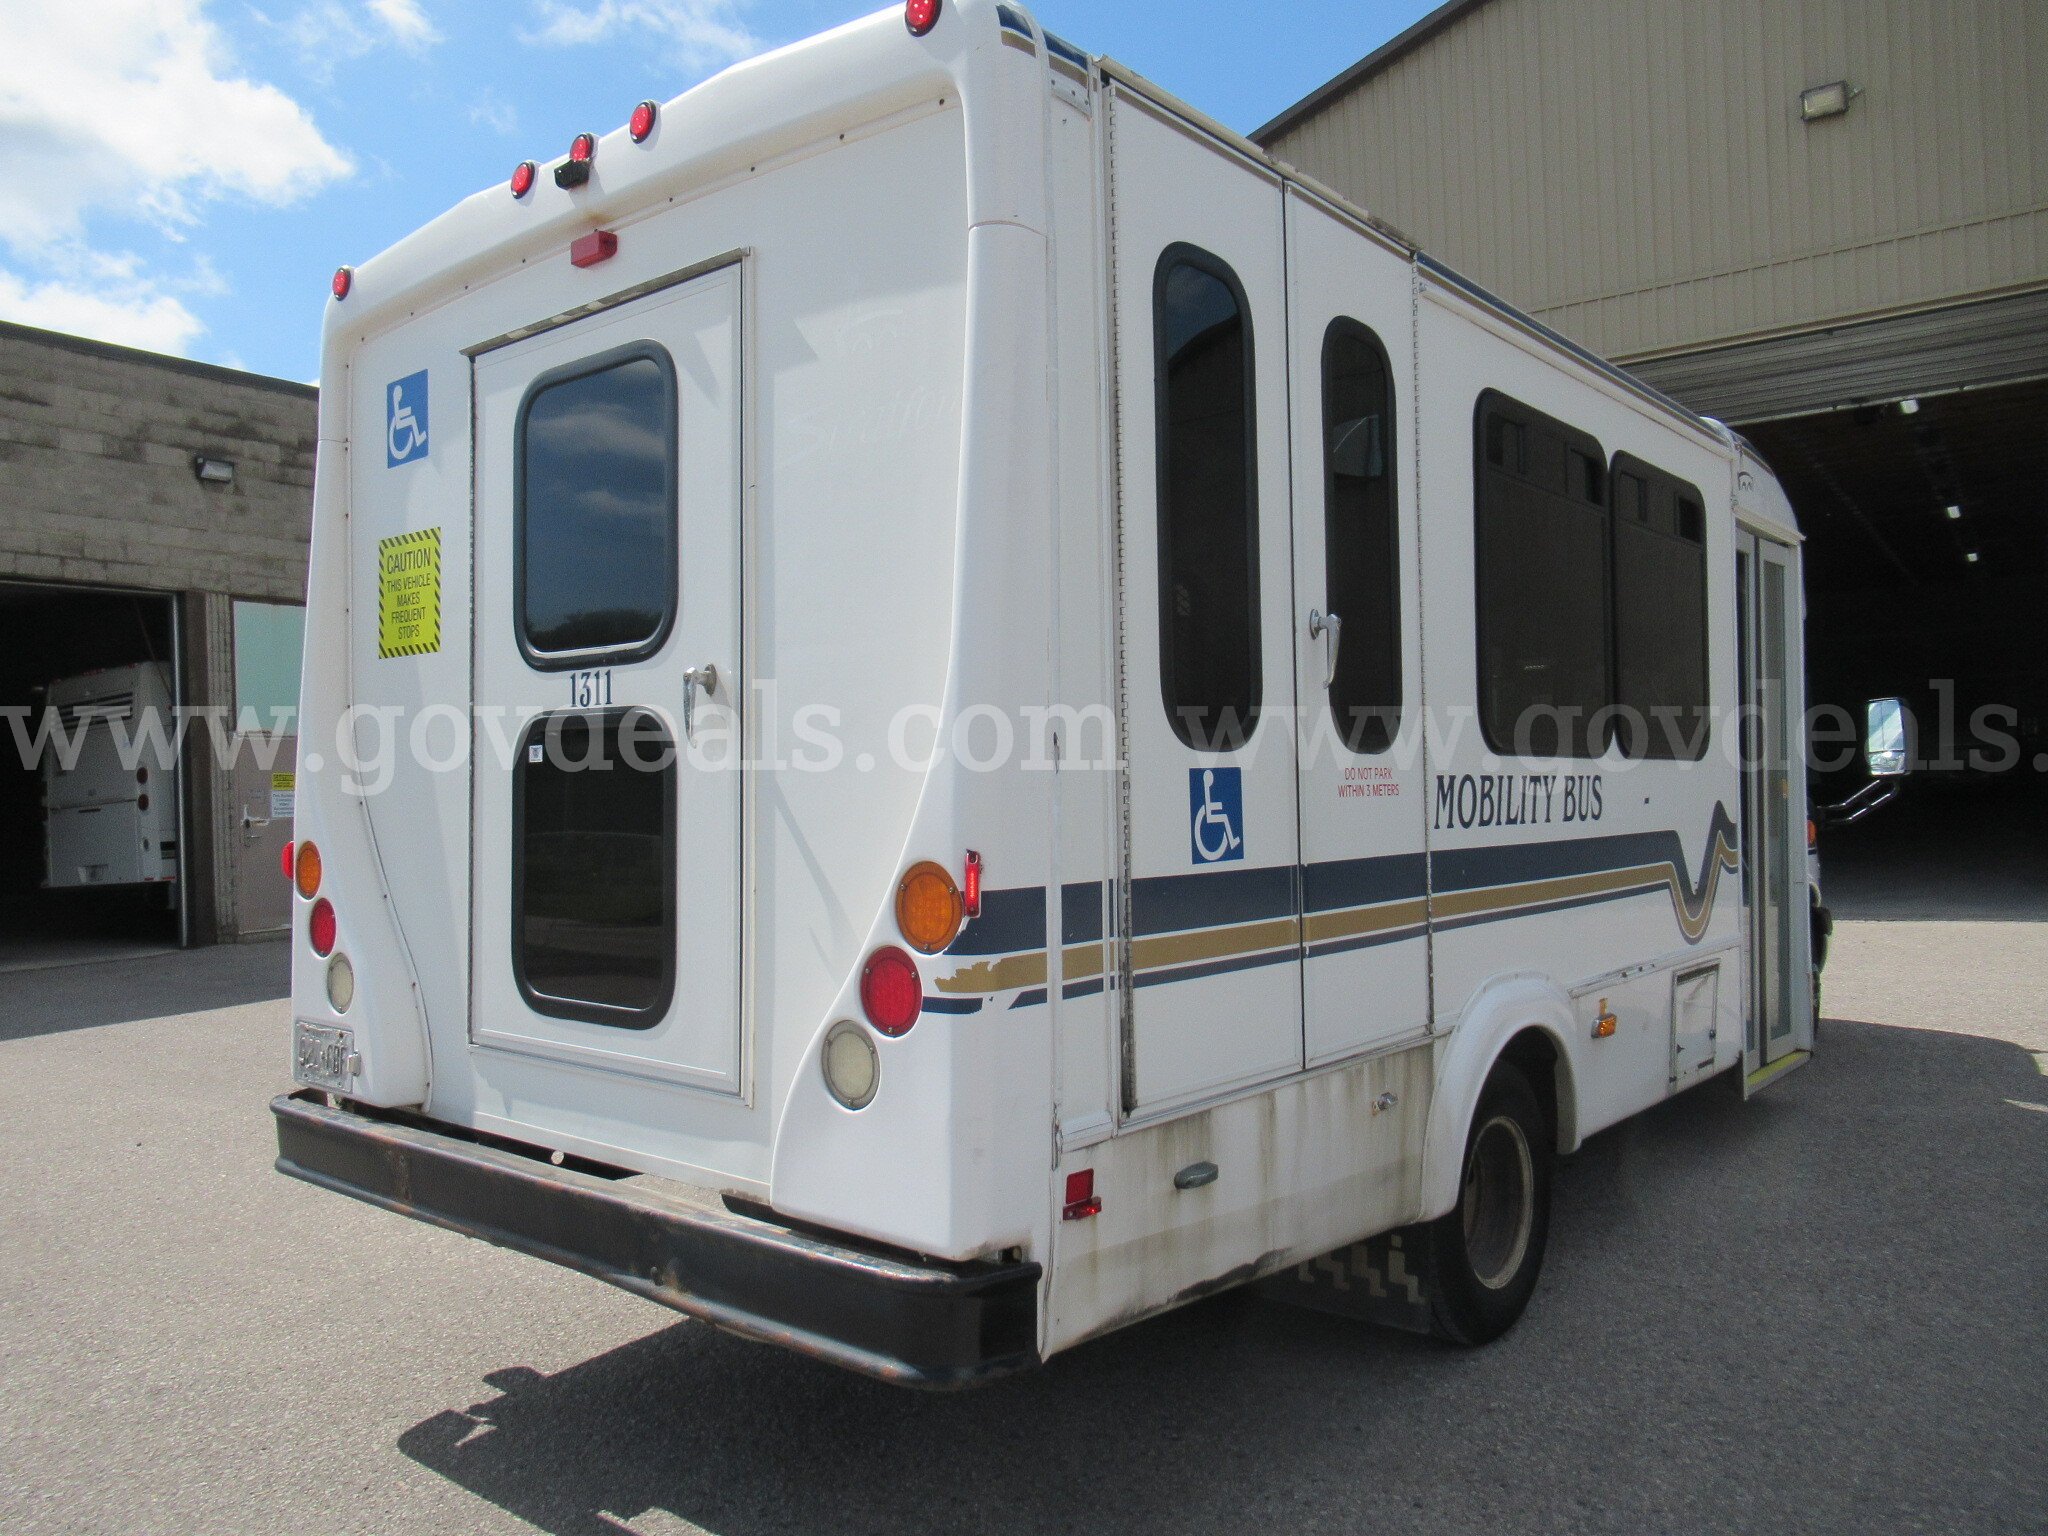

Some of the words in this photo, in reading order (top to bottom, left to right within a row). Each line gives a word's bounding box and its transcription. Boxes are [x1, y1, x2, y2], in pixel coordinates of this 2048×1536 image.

[387, 547, 431, 574] CAUTION
[386, 578, 401, 593] THIS
[403, 573, 431, 590] VEHICLE
[397, 591, 420, 607] MAKES
[391, 607, 426, 624] FREQUENT
[398, 624, 419, 640] STOPS
[570, 669, 613, 707] 1311
[1344, 767, 1356, 780] DO
[1358, 767, 1372, 780] NOT
[1374, 767, 1392, 780] PARK
[1338, 784, 1364, 797] WITHIN
[1366, 784, 1370, 796] 3
[1372, 784, 1399, 796] METERS
[1434, 774, 1557, 829] MOBILITY
[1562, 774, 1603, 822] BUS
